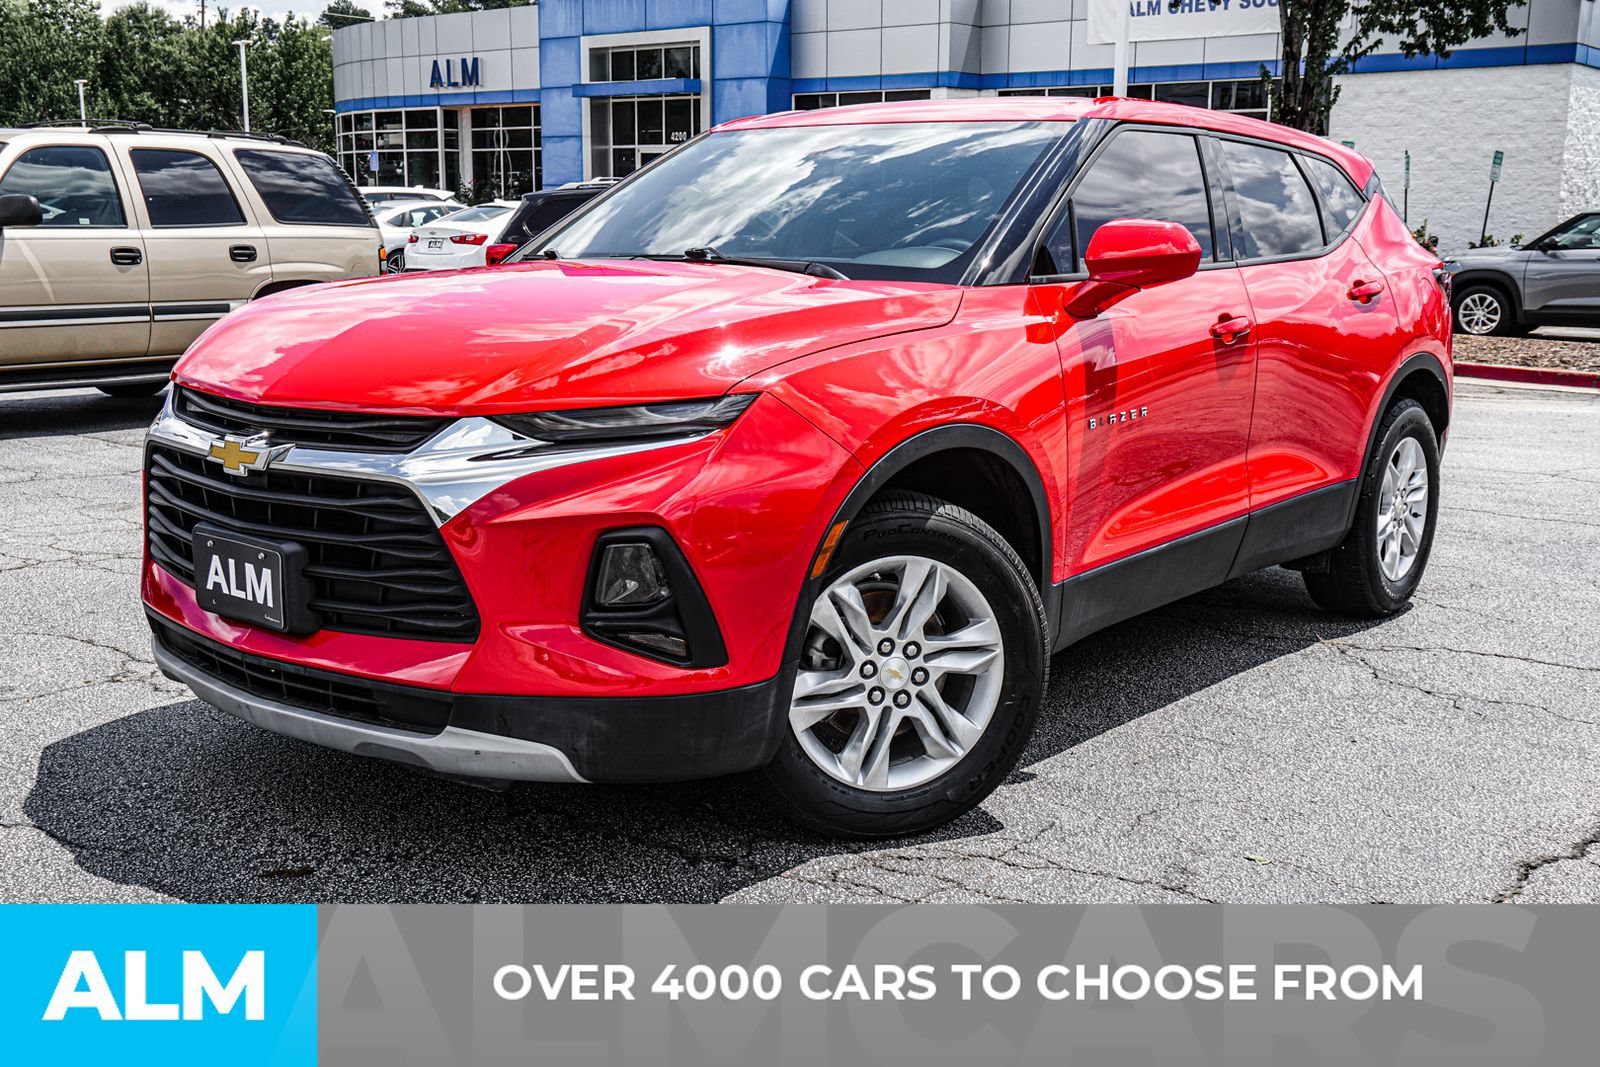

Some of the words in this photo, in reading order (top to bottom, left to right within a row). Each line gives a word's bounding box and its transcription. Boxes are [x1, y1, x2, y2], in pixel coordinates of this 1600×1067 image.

[429, 57, 480, 88] ALM
[670, 131, 687, 141] 4200
[1088, 407, 1148, 430] BLAZER
[206, 554, 274, 609] ALM
